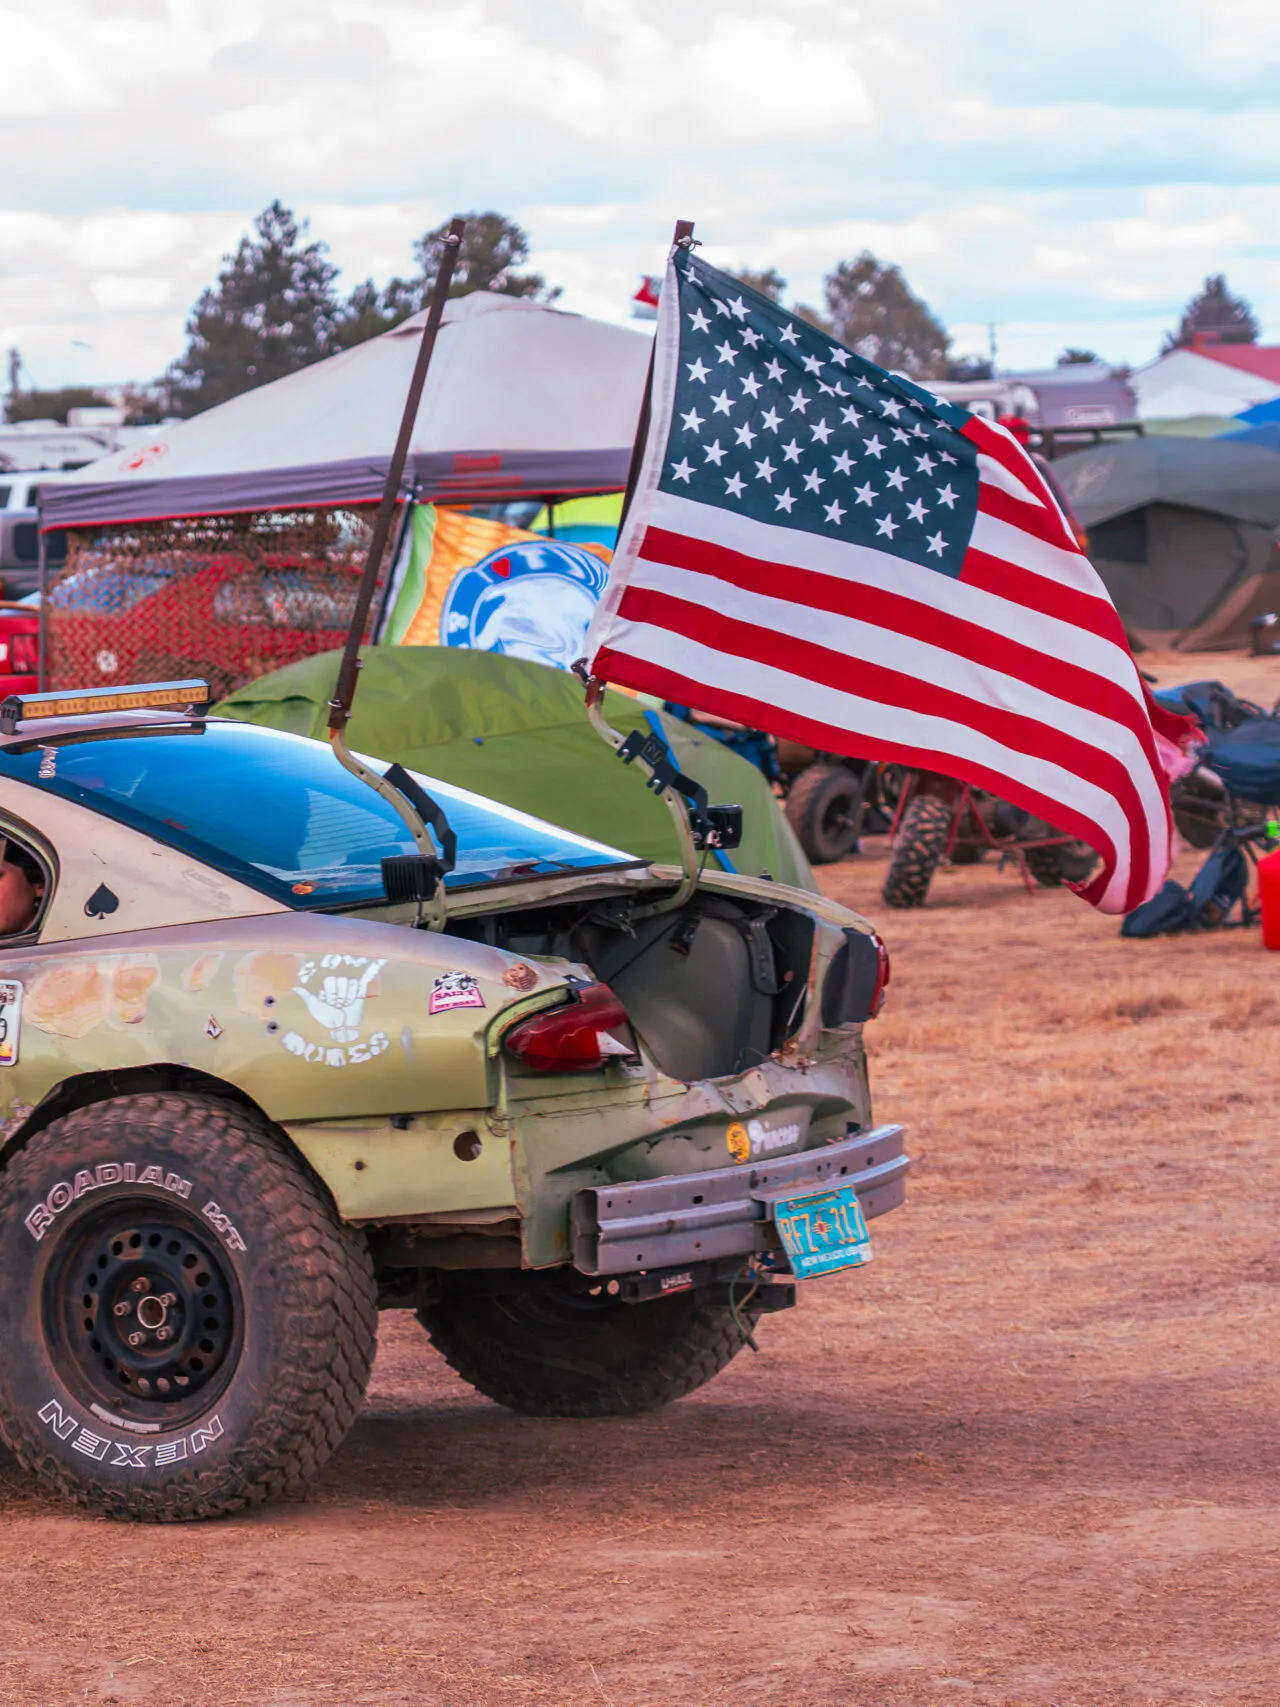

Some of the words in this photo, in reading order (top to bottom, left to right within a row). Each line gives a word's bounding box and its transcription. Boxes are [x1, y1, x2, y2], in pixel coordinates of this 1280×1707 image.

[24, 1162, 194, 1242] ROADIAN
[201, 1200, 248, 1252] MT
[661, 1272, 693, 1289] U-HAUL
[37, 1399, 224, 1468] NEXEN
